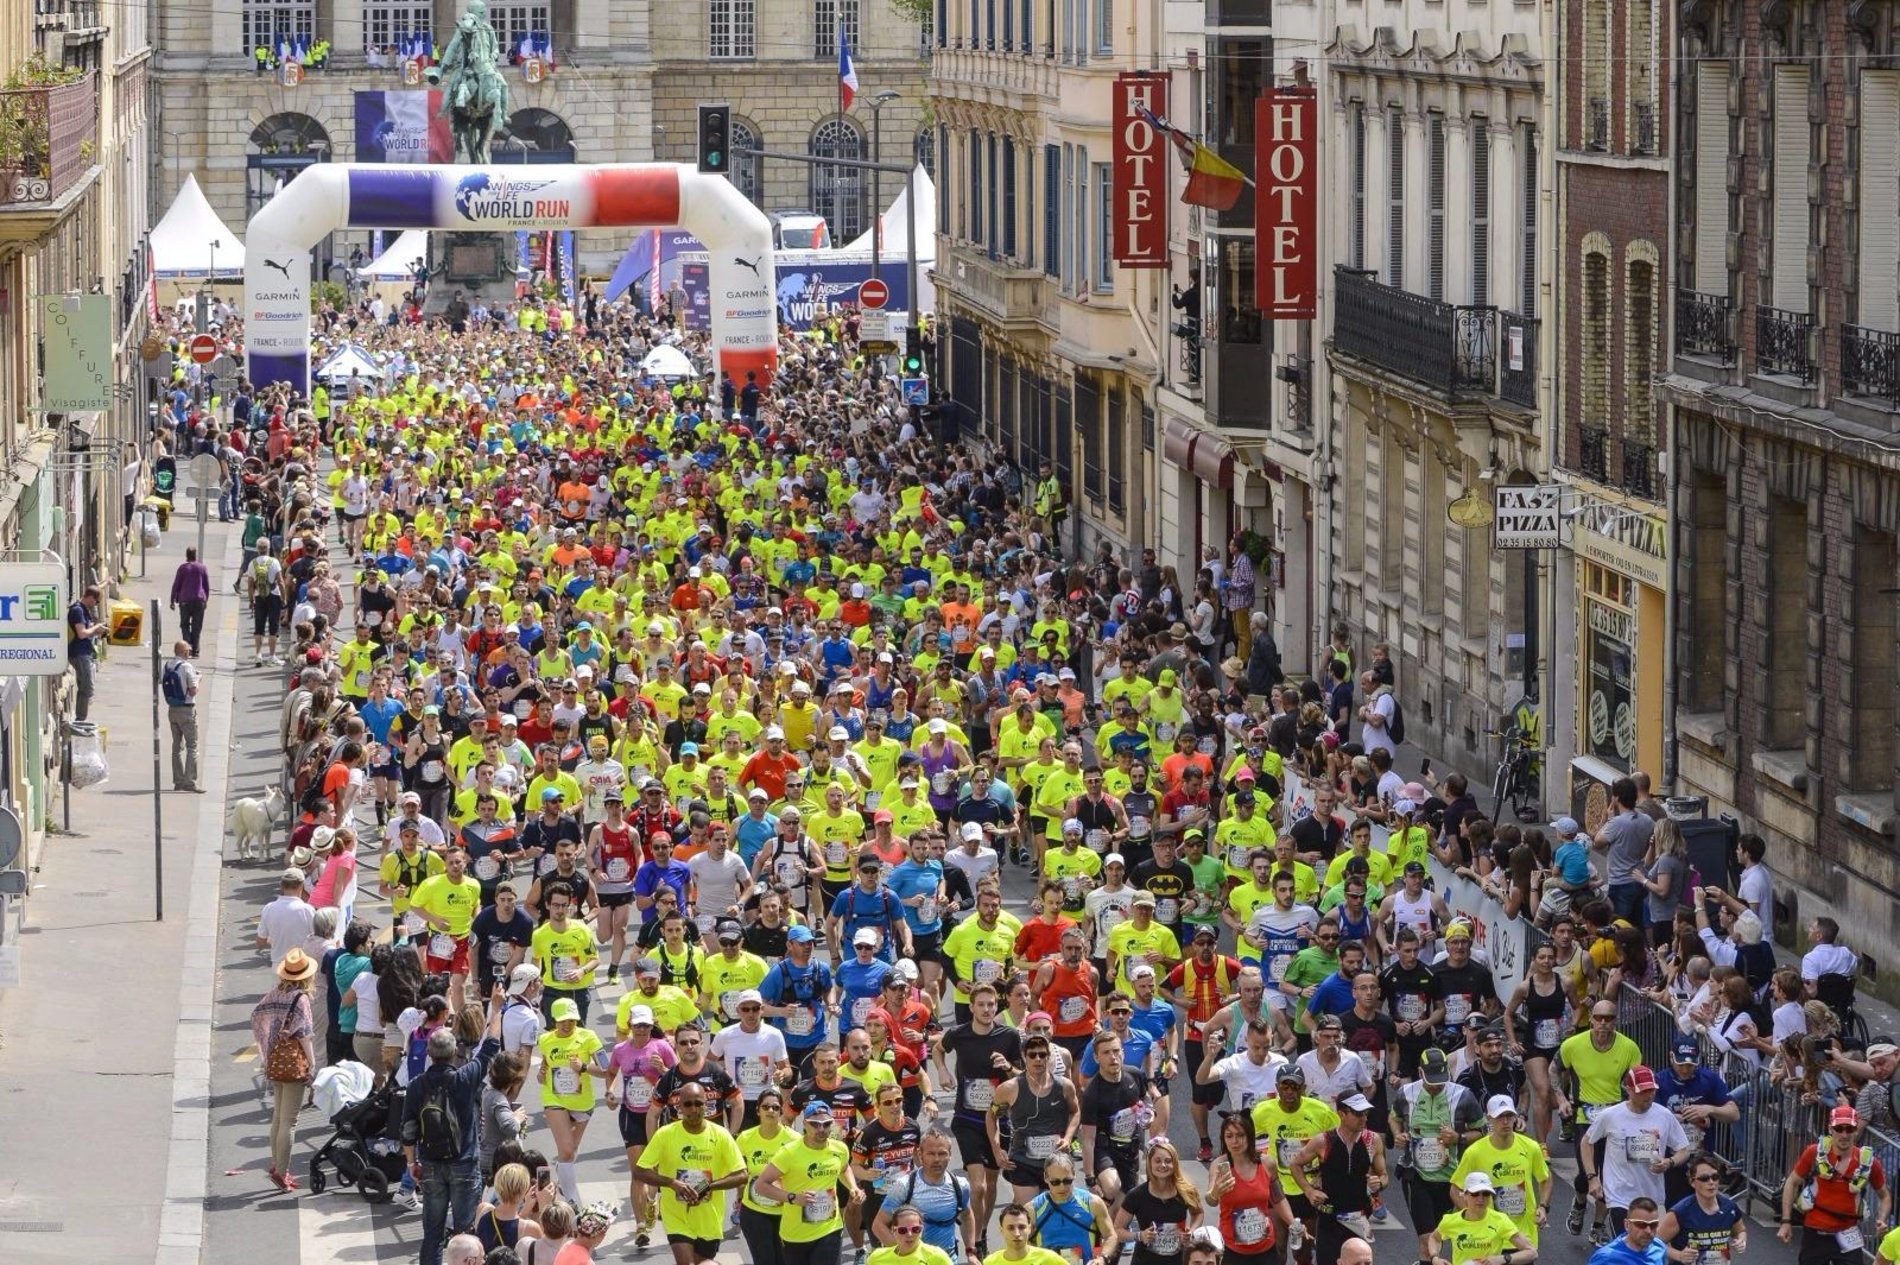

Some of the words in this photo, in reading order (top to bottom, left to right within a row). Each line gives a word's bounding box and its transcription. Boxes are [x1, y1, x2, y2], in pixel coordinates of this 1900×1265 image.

[385, 138, 420, 150] WORLD
[1125, 85, 1154, 256] HOTEL
[490, 182, 531, 190] WINGS
[496, 192, 518, 200] LIFE
[475, 201, 533, 218] WORLD
[536, 200, 569, 217] RUN
[1270, 104, 1304, 304] HOTEL
[255, 293, 300, 301] GARMIN
[726, 290, 769, 299] GARMIN
[253, 338, 277, 346] FRANCE
[725, 336, 750, 344] FRANCE
[47, 302, 111, 397] COIFFURE
[50, 399, 110, 409] Visagiste
[1498, 515, 1557, 531] PIZZA
[1497, 538, 1508, 547] 02
[1510, 538, 1520, 547] 35
[1522, 538, 1532, 547] 15
[0, 595, 19, 621] r
[0, 649, 57, 660] REGIONAL
